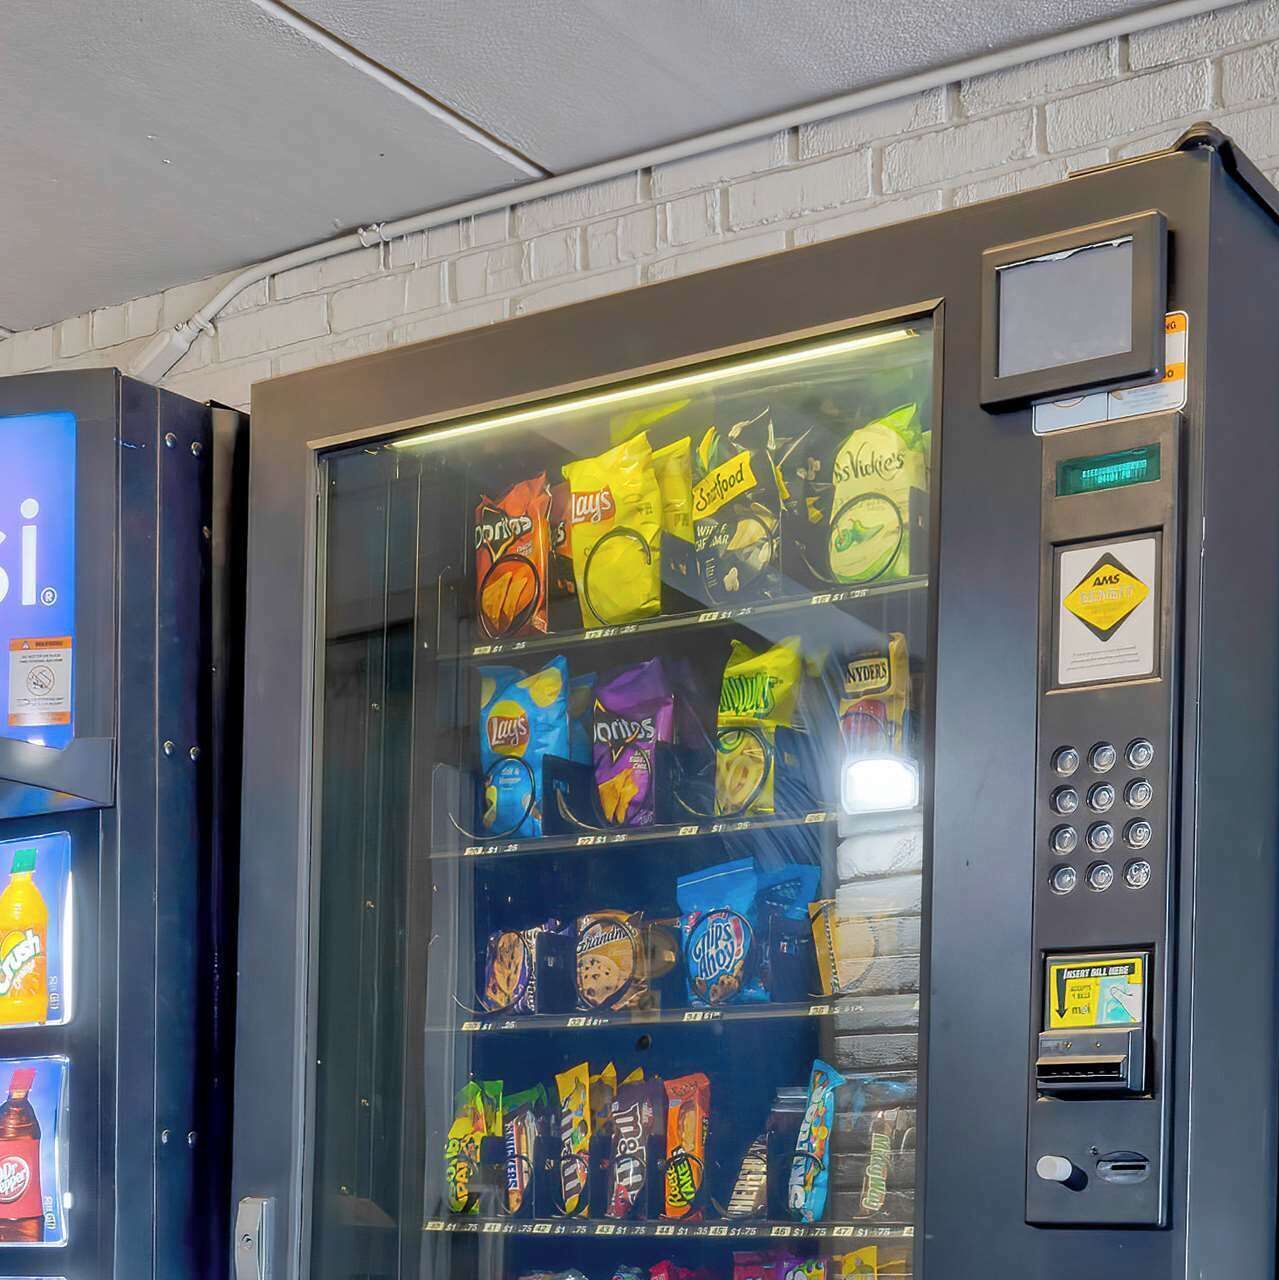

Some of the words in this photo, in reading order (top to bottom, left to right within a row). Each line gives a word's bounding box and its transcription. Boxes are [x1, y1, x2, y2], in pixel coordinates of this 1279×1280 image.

[571, 490, 611, 523] Lay's
[1093, 574, 1119, 587] AMS
[846, 662, 888, 684] NYDER'S
[1064, 968, 1090, 979] INSERT
